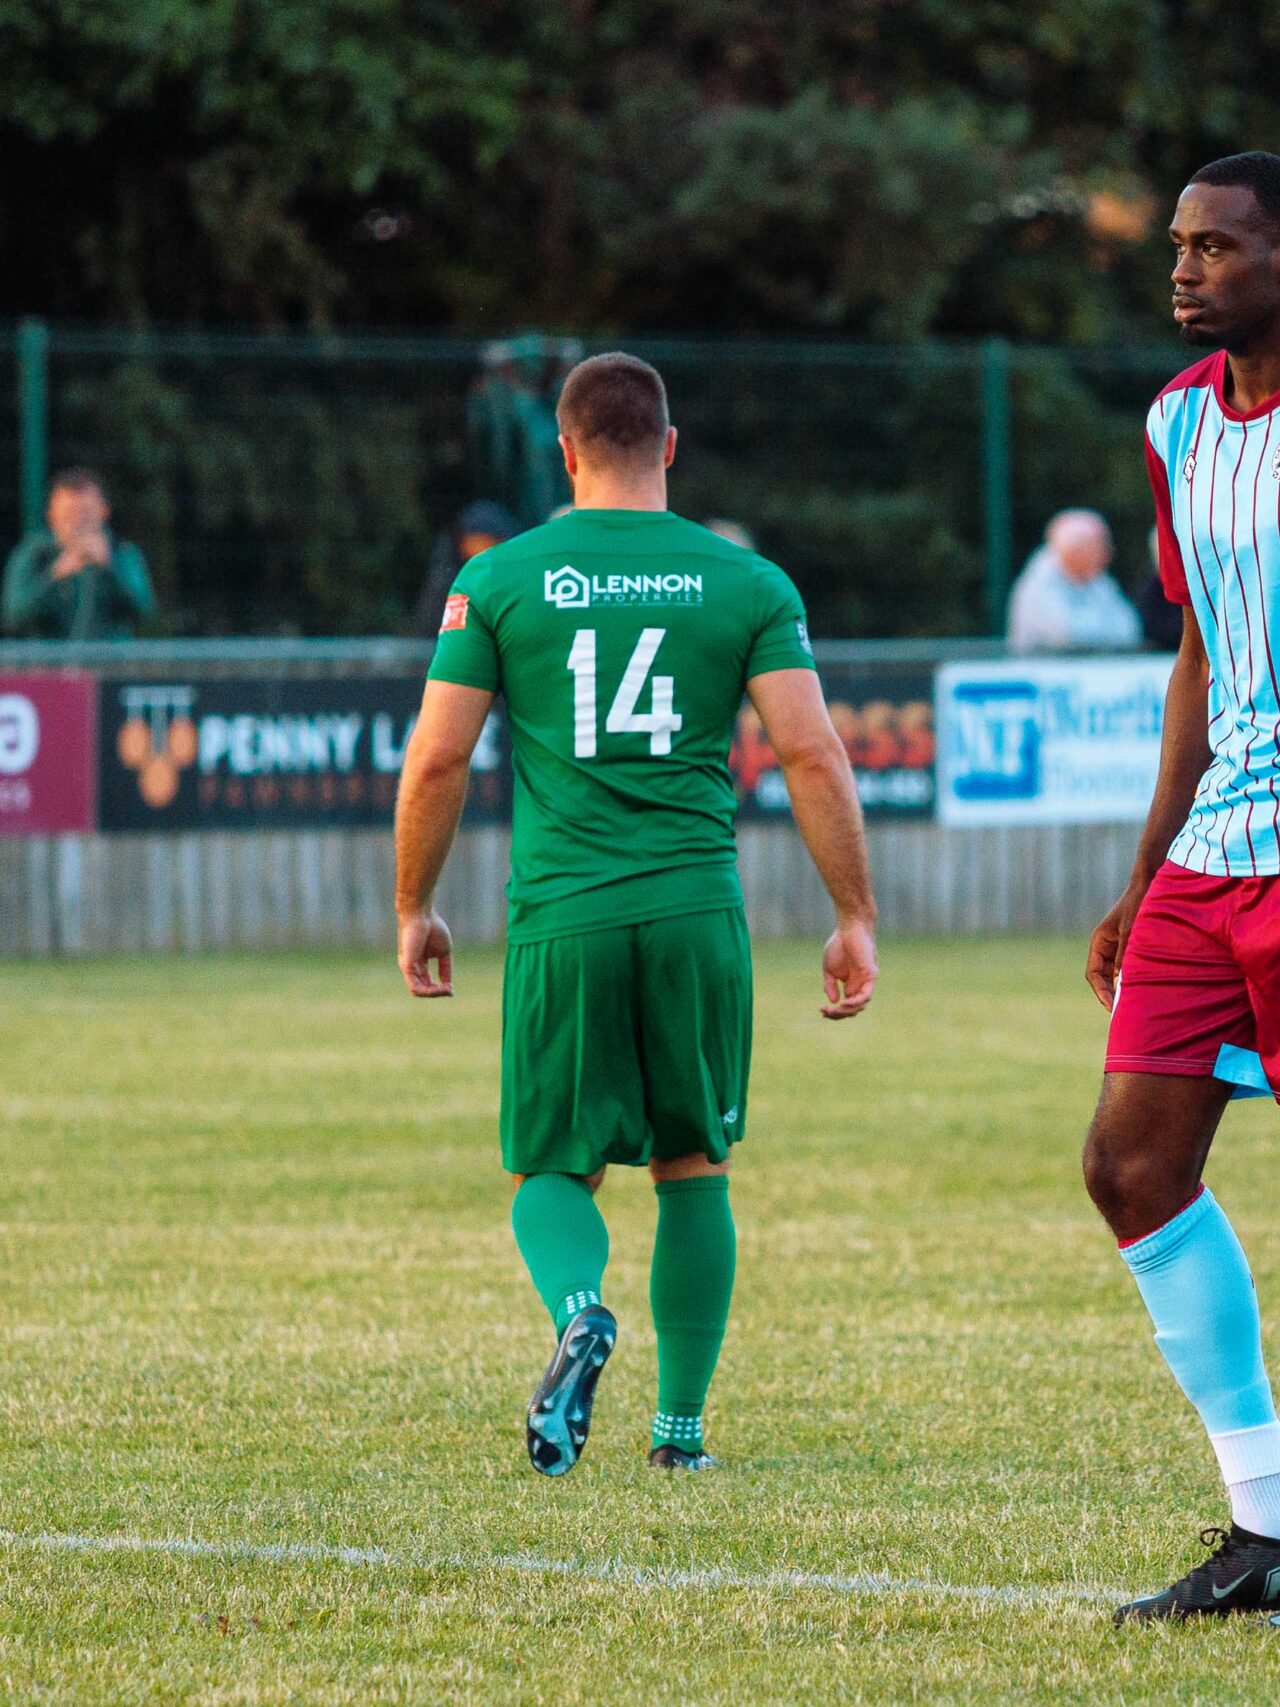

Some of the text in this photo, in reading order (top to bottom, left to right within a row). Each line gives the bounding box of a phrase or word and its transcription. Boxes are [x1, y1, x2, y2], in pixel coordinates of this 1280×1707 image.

[592, 574, 703, 593] LENNON
[592, 594, 704, 603] PROPERTIES
[566, 628, 683, 758] 14
[199, 713, 363, 774] PENNY
